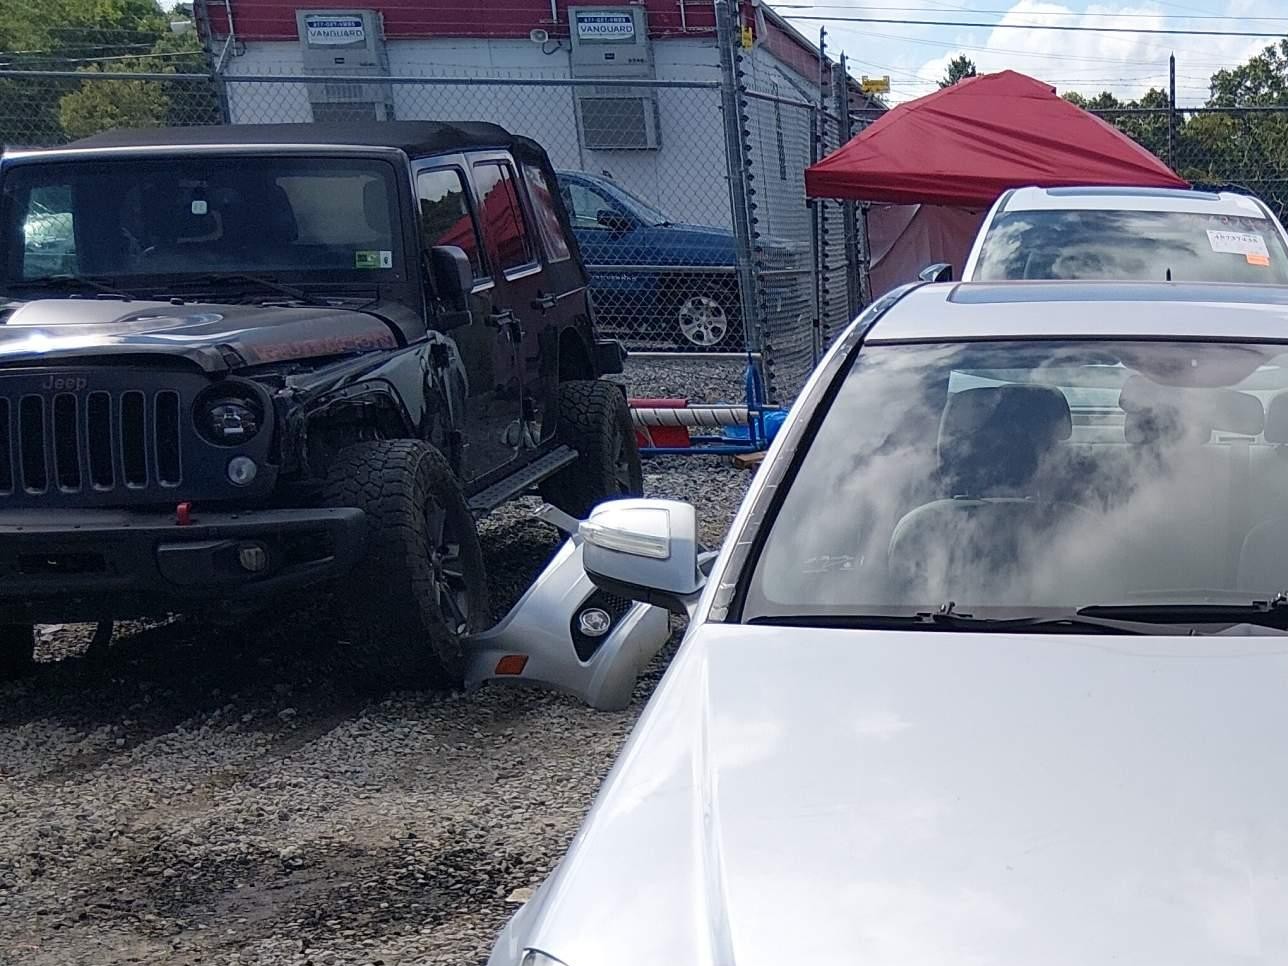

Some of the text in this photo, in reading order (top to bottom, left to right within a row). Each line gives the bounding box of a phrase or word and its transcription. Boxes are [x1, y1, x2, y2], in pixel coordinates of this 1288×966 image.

[310, 29, 363, 37] VANGUARD
[580, 25, 633, 33] VANGUARD
[42, 375, 88, 391] Jeep
